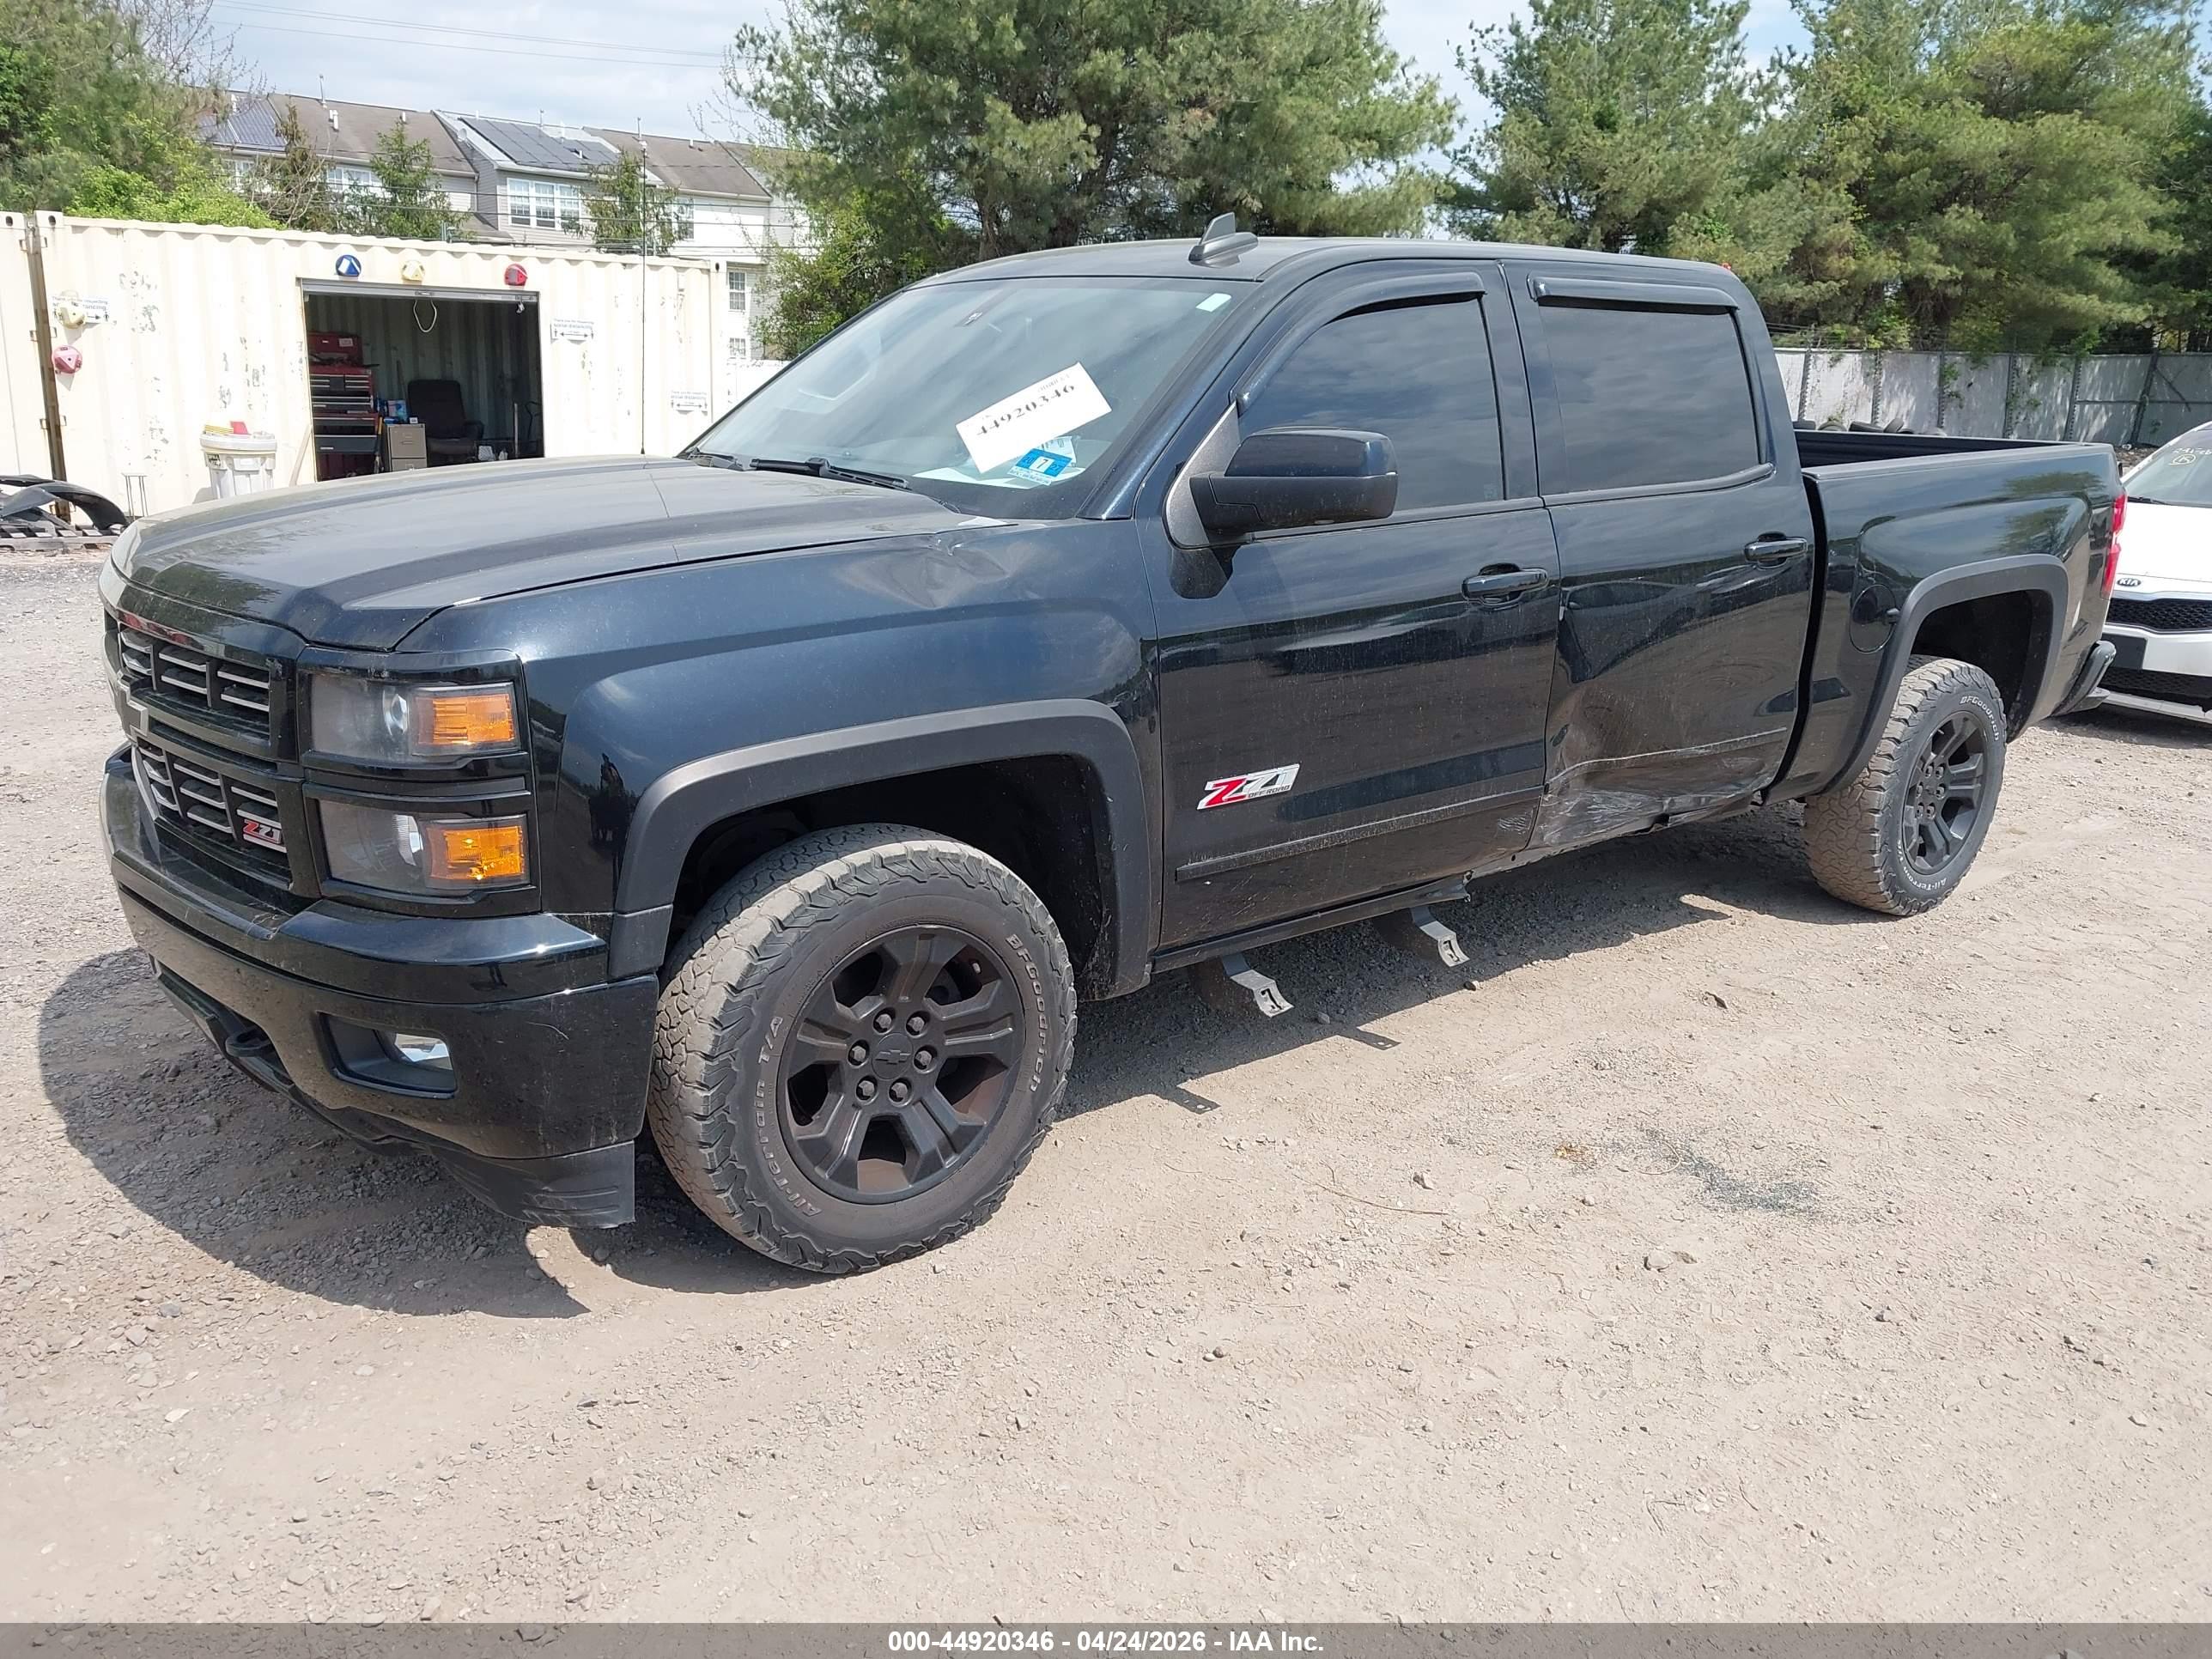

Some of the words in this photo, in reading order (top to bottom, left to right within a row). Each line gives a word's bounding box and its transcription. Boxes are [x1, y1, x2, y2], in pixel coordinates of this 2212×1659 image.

[976, 384, 1075, 435] 44920346
[1036, 459, 1048, 469] 7
[1197, 763, 1300, 810] Z71
[1248, 790, 1266, 799] OFF
[1267, 785, 1291, 794] ROAD
[243, 818, 282, 844] Z71
[1005, 933, 1048, 1092] BFGoodrich
[757, 1016, 783, 1064] T/A
